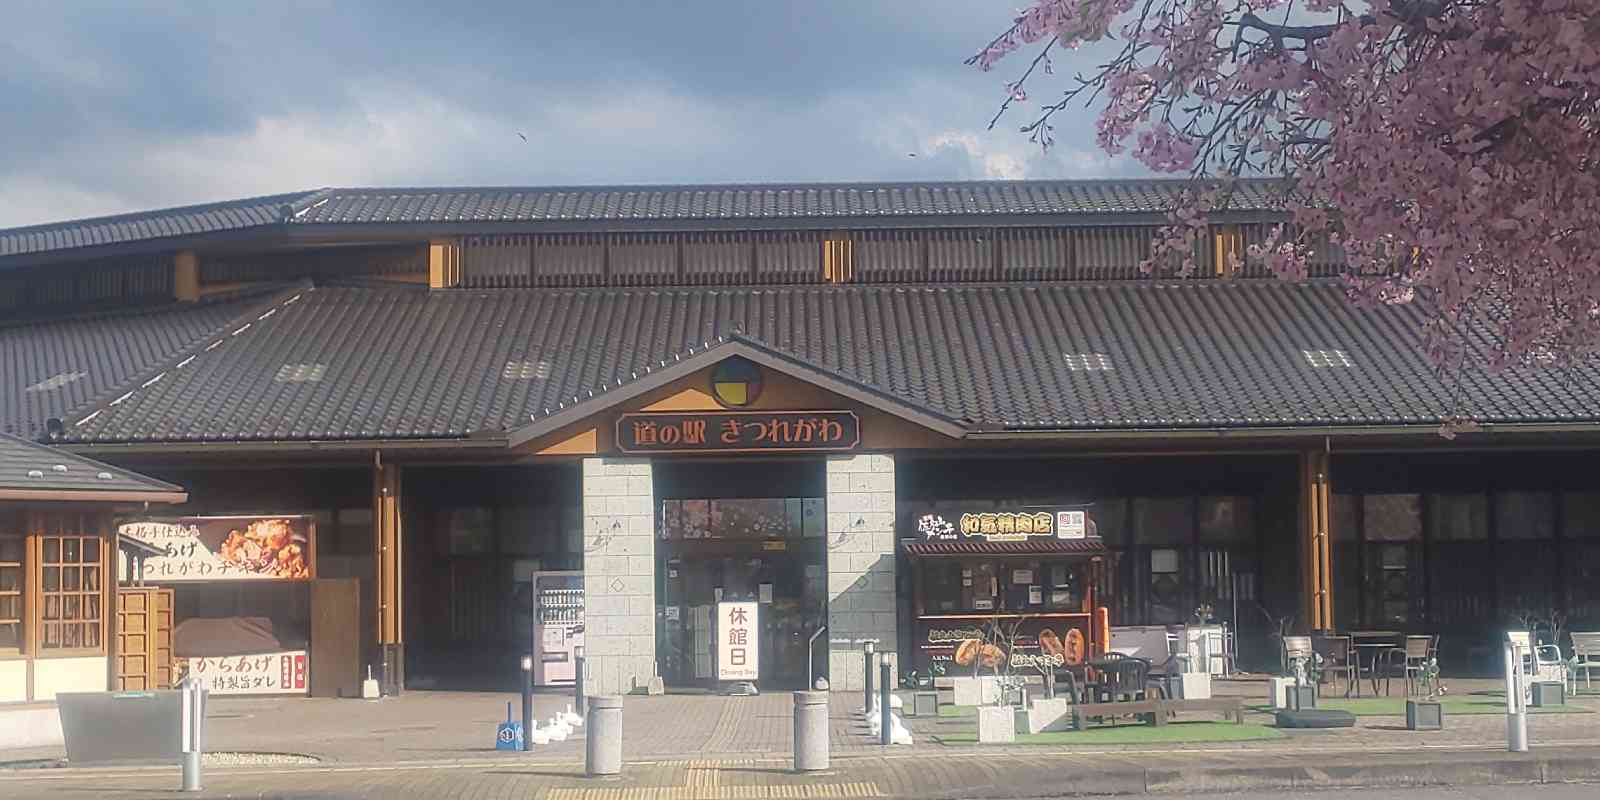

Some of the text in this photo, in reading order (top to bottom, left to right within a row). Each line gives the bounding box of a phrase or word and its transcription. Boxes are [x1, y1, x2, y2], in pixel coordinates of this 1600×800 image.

[633, 418, 843, 445] 道の駅 きつれがわ
[143, 560, 282, 577] つれがわチキン
[729, 607, 748, 666] 休館日
[197, 656, 273, 673] からあげ
